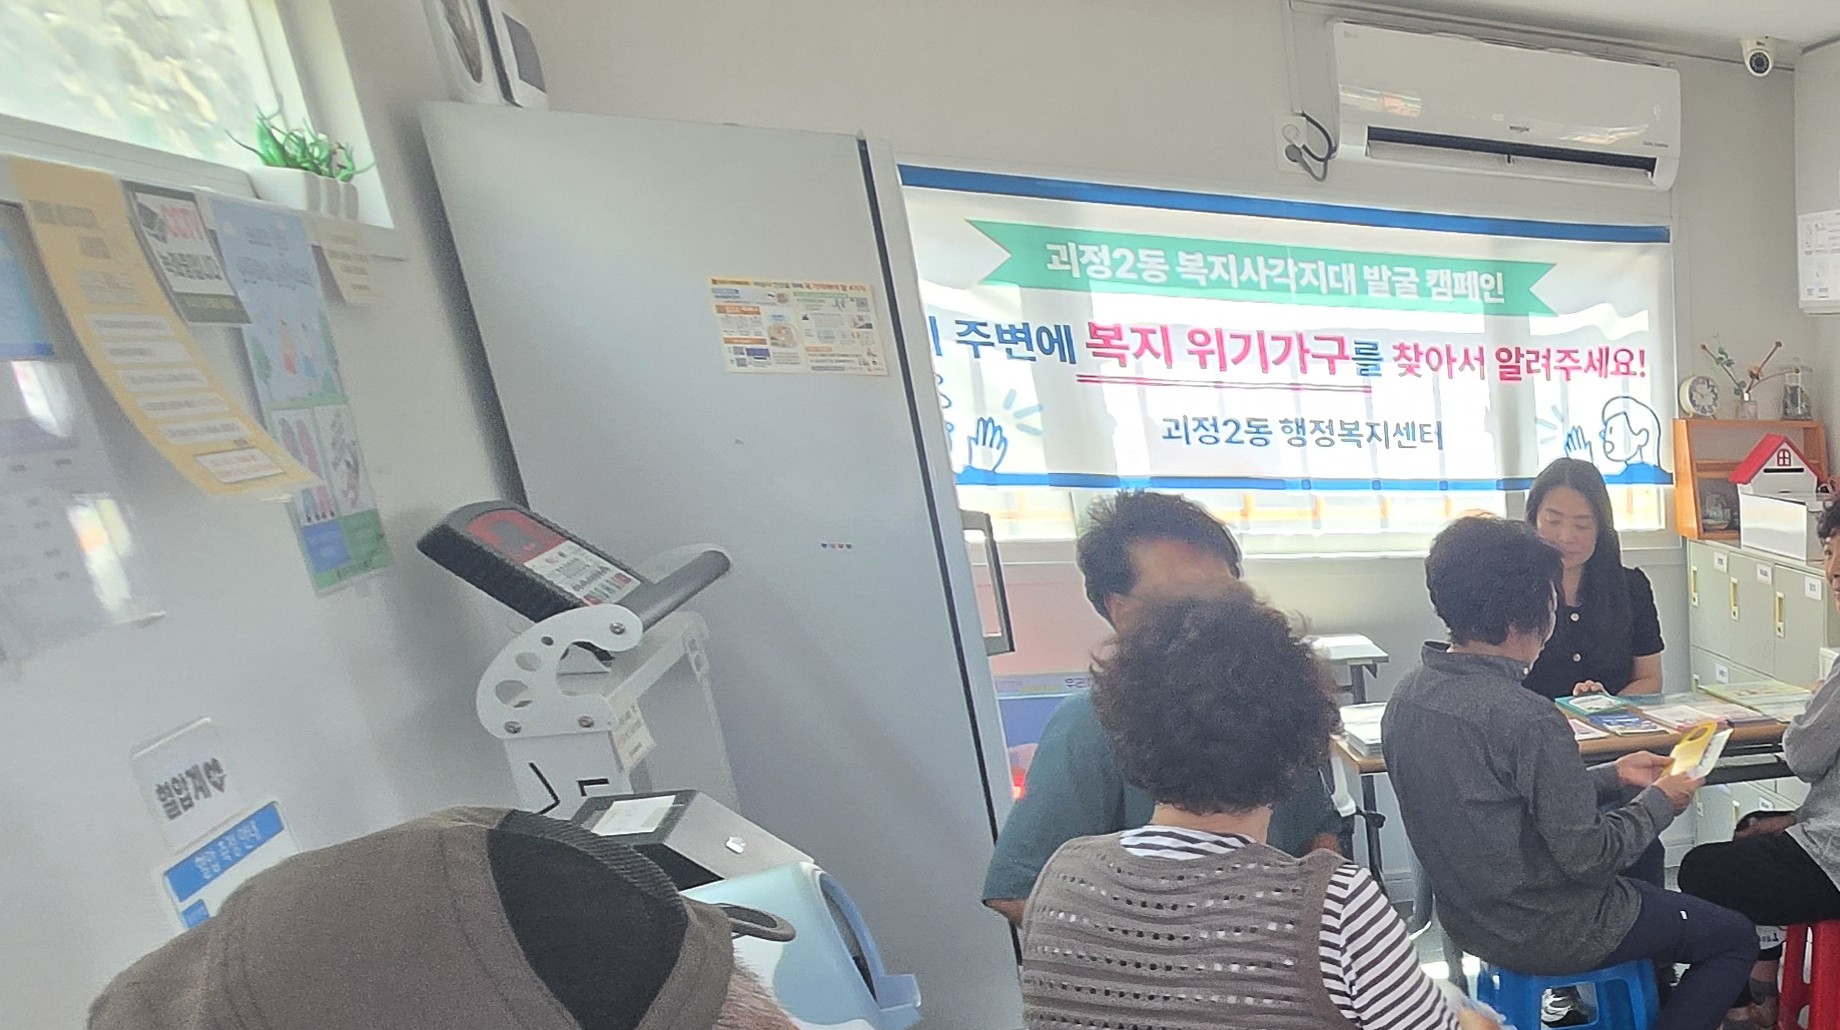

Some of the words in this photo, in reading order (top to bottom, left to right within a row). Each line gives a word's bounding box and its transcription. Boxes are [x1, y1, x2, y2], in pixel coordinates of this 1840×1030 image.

[1046, 241, 1170, 283] 괴정2동
[1175, 250, 1359, 297] 복지사각지대
[1363, 264, 1420, 298] 발굴
[1425, 268, 1506, 304] 캠페인
[954, 318, 1078, 365] 주변에
[1085, 321, 1173, 370] 복지
[1187, 327, 1384, 377] 위기가구를
[1392, 341, 1486, 380] 찾아서
[1494, 345, 1647, 382] 알려주세요!
[1162, 414, 1273, 447] 괴정2동
[1278, 416, 1444, 450] 행정복지센터
